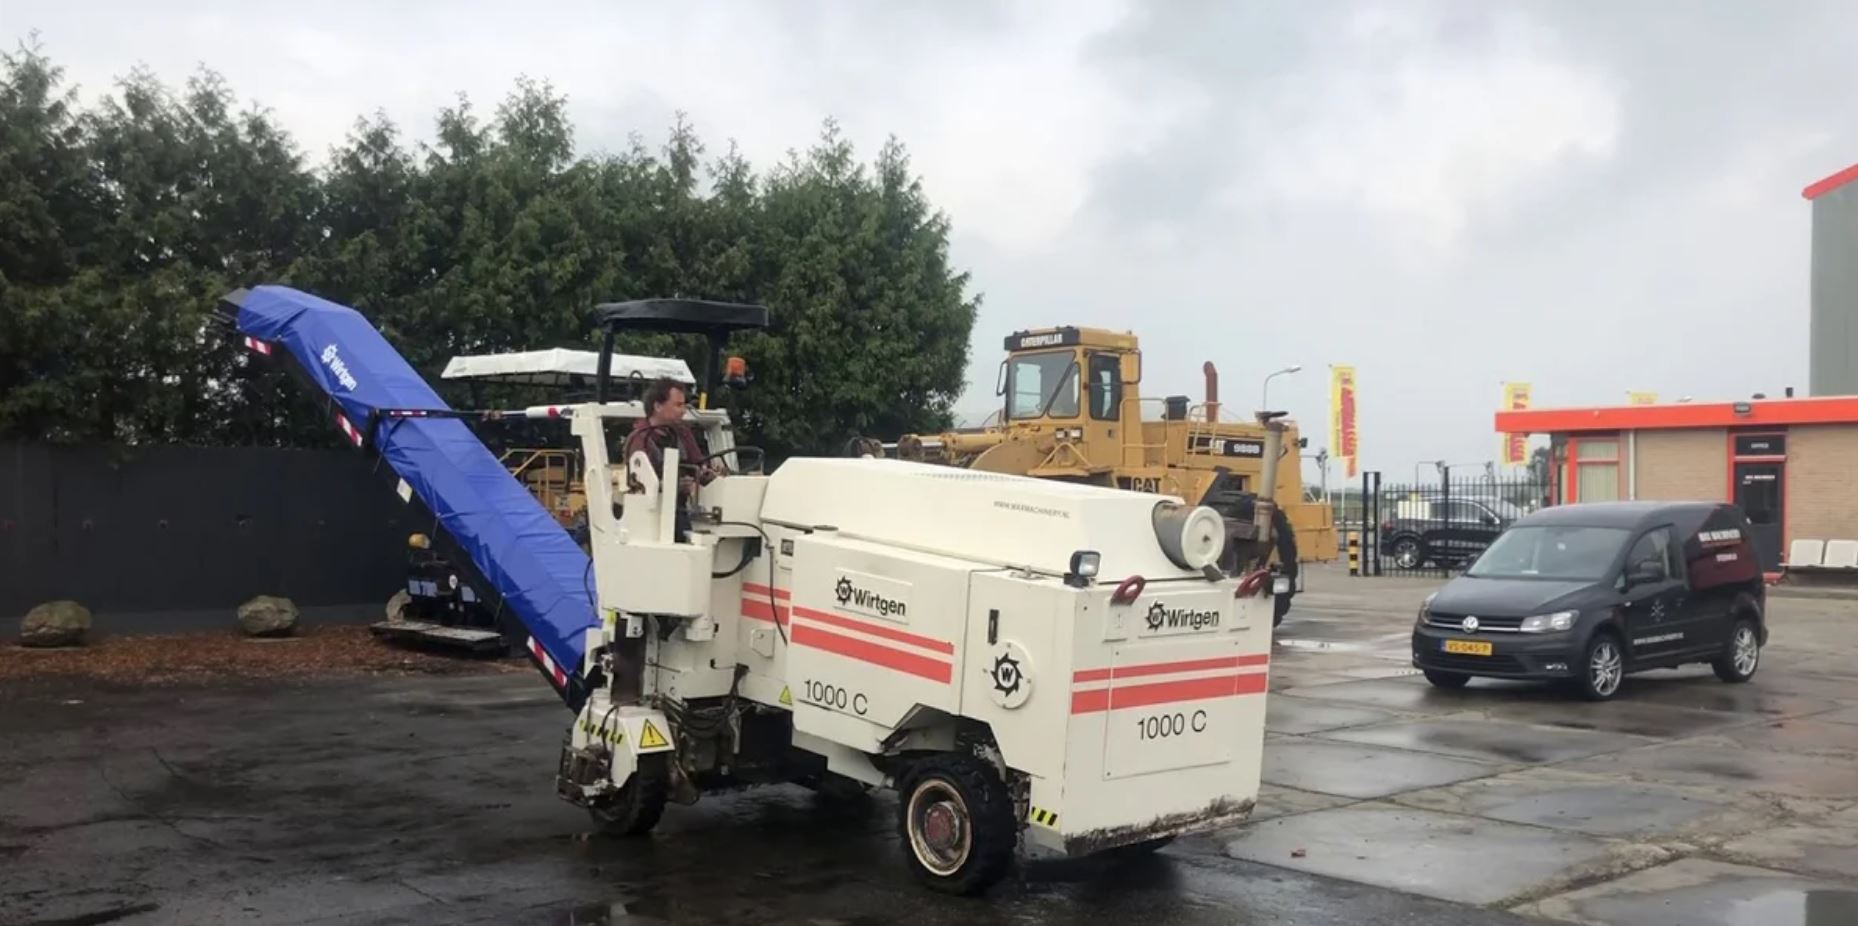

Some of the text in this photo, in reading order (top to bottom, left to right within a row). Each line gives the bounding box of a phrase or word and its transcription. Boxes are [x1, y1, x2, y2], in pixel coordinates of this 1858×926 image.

[1021, 333, 1063, 348] CATERPILLAR
[329, 356, 358, 392] Wirtgen
[1133, 477, 1162, 494] CAT
[853, 587, 906, 616] Wirtgen
[1167, 609, 1219, 629] Wirtgen
[804, 678, 868, 715] 1000 C
[1137, 710, 1207, 740] 1000 C
